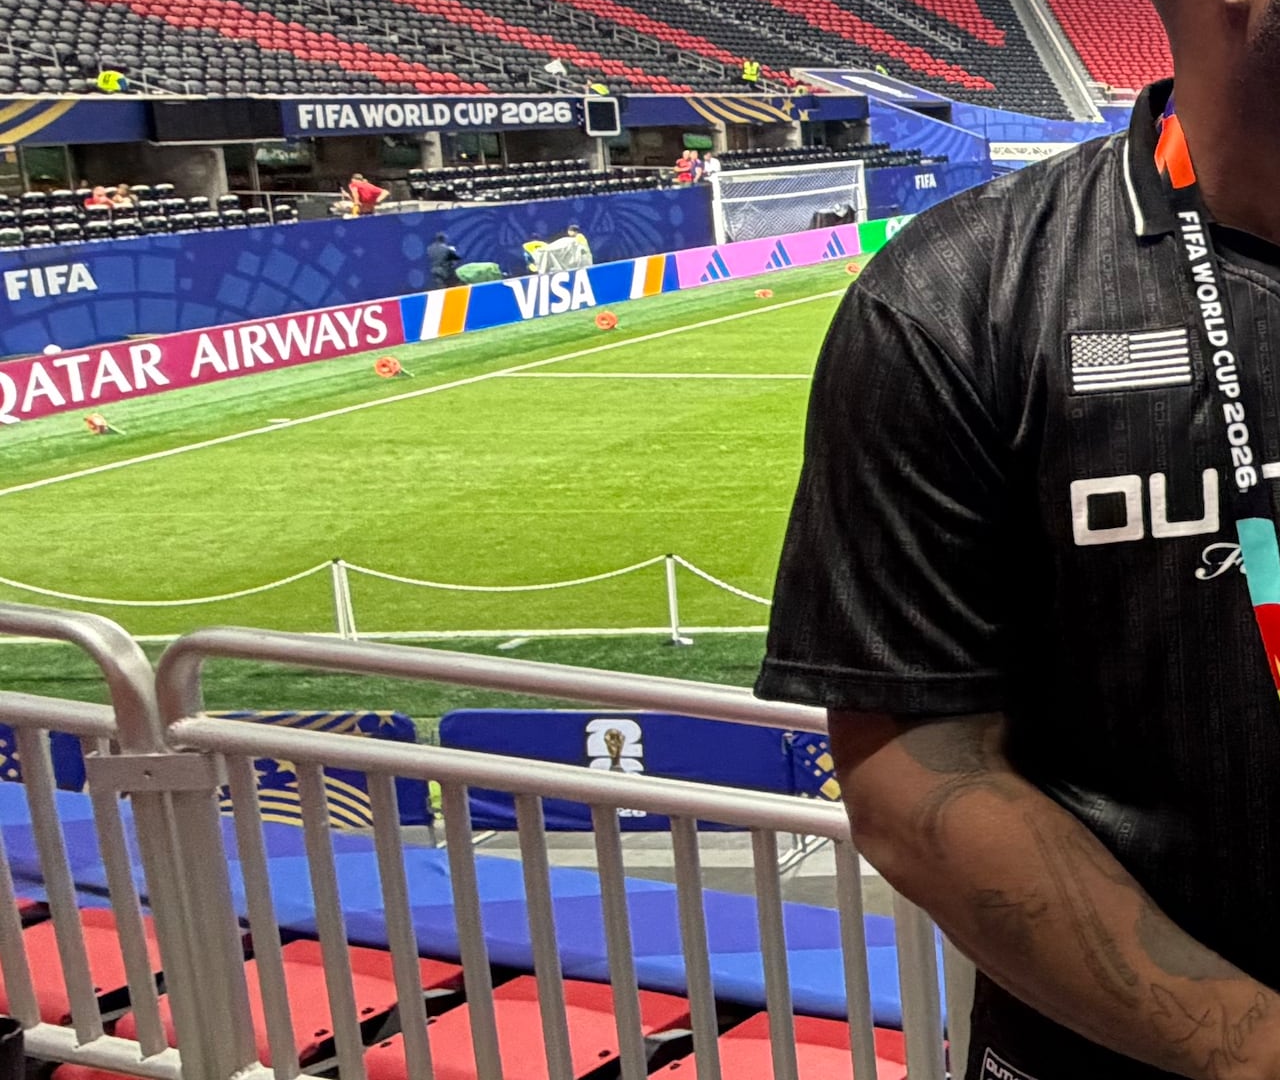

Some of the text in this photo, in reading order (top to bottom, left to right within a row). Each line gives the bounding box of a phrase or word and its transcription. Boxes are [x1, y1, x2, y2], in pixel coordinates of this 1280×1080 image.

[298, 101, 573, 129] FIFA WORLD CUP 2026
[3, 262, 99, 300] FIFA
[503, 268, 597, 320] VISA
[190, 304, 388, 379] AIRWAYS
[1177, 210, 1258, 490] FIFA WORLD CUP 2026
